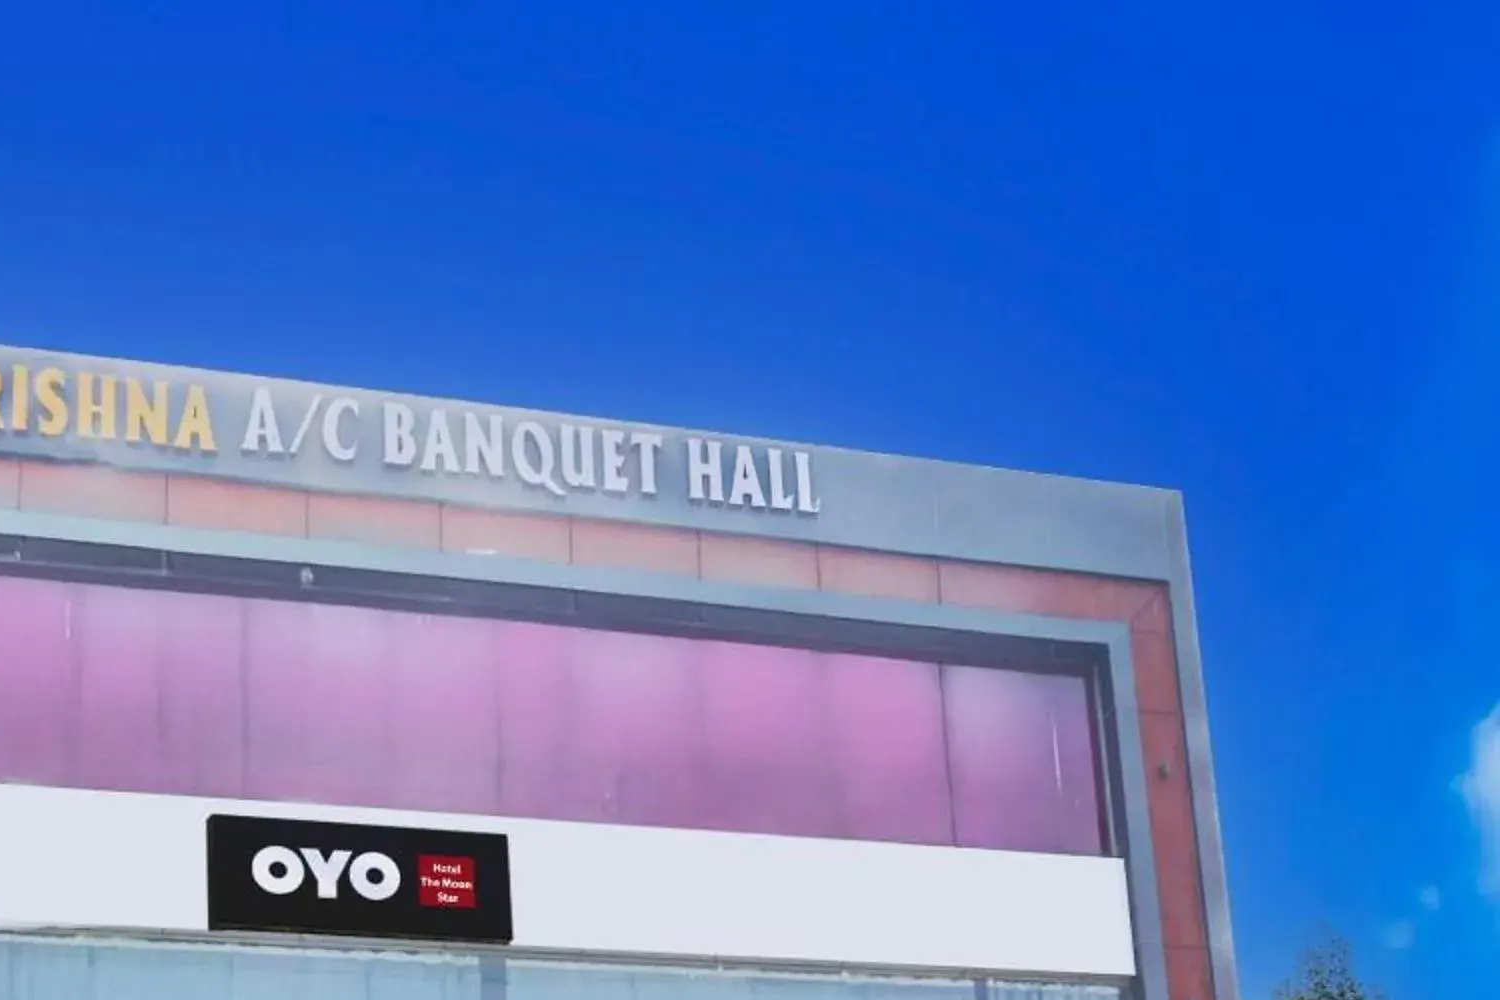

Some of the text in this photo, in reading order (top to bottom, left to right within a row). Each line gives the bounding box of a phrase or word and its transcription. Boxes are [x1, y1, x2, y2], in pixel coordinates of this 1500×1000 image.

[240, 388, 360, 462] A/C
[382, 401, 663, 496] BANQUET
[687, 437, 822, 513] HALL
[251, 845, 401, 901] OYO
[433, 863, 461, 875] Hotel
[420, 876, 441, 888] The
[437, 891, 459, 903] Star
